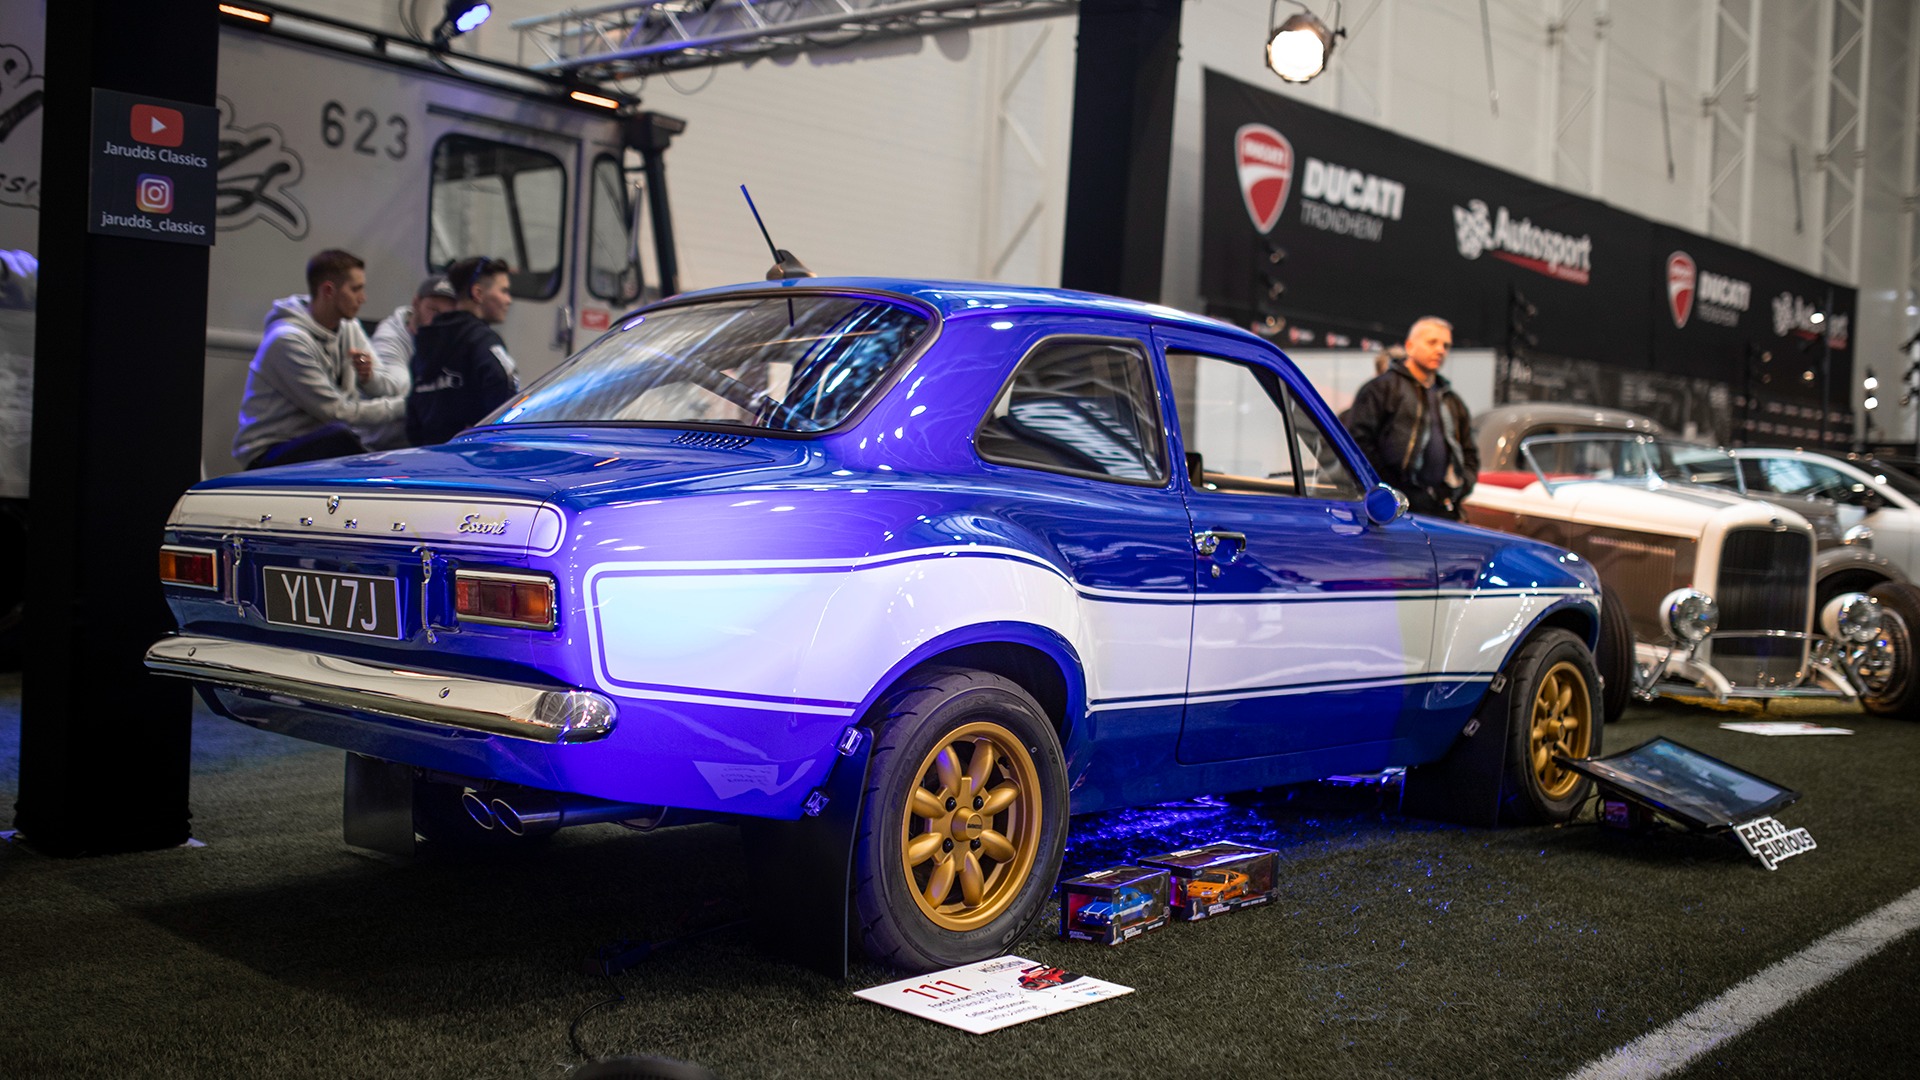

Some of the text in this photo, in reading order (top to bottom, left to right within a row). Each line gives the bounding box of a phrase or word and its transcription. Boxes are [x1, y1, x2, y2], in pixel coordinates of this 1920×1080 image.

[321, 100, 408, 161] 623
[104, 141, 208, 168] Jarudds Classics
[1301, 156, 1405, 221] DUCATI
[101, 212, 206, 236] jarudds_classics
[1493, 206, 1592, 274] Autosport
[456, 512, 512, 535] Escort
[281, 573, 378, 632] YLV7J
[1757, 830, 1814, 867] FURIOUS
[902, 980, 972, 999] 111
